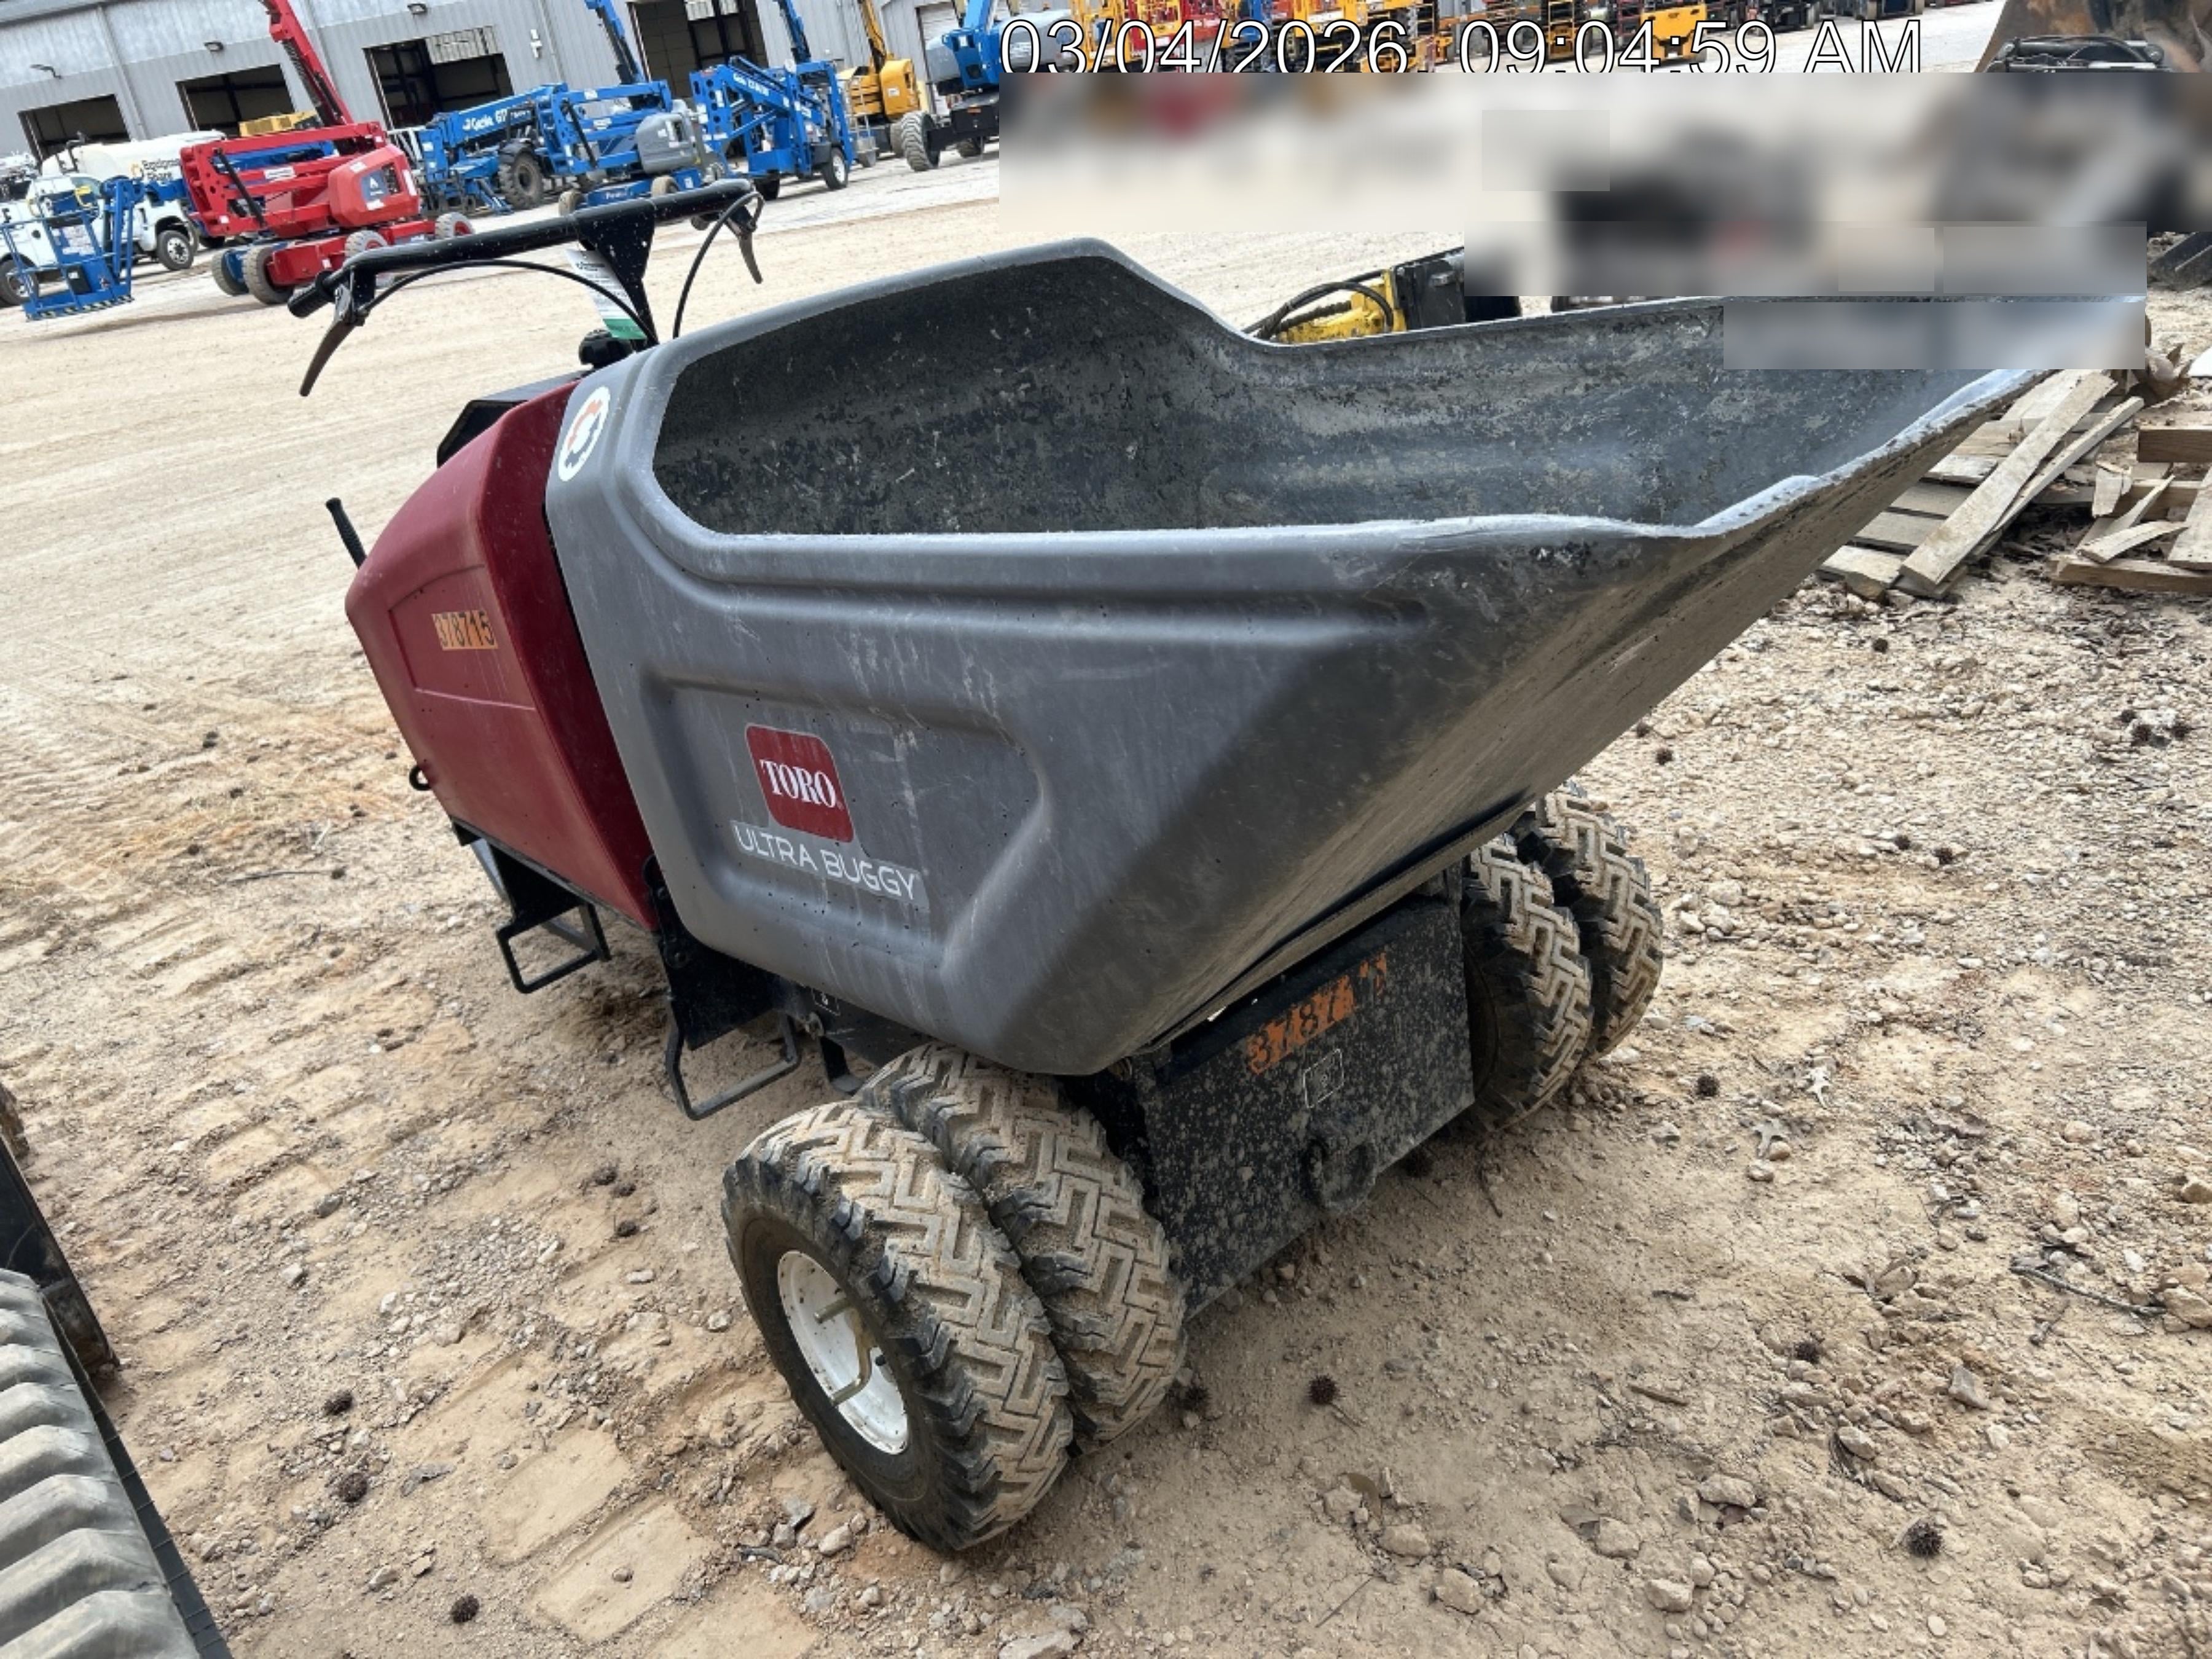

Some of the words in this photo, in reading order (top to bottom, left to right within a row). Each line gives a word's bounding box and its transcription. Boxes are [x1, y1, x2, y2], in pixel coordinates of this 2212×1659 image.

[432, 611, 495, 647] 378715
[759, 758, 837, 809] TORO
[734, 824, 819, 871] ULTRA
[820, 849, 919, 900] BUGGY
